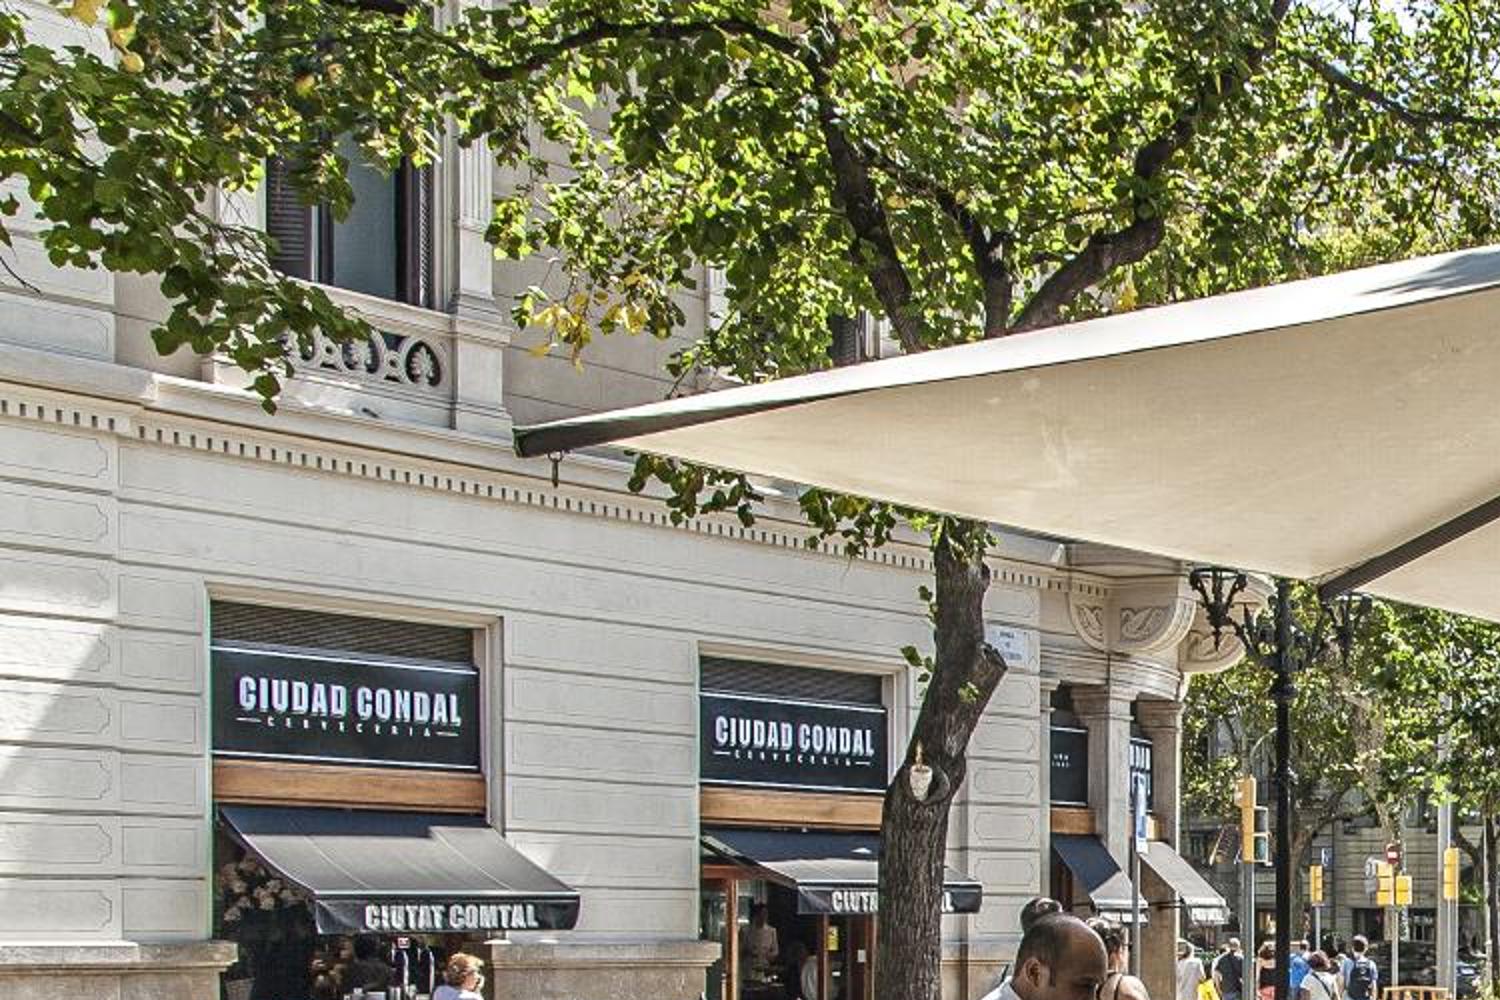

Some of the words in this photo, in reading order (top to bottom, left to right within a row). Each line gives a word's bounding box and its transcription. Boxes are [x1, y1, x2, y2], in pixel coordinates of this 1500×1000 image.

[238, 676, 347, 718] CIUDAD
[356, 686, 462, 727] CONDAL
[714, 715, 793, 750] CIUDAD
[798, 723, 875, 757] CONDAL
[365, 904, 446, 930] CIUTAT
[450, 904, 539, 929] COMTAL
[832, 890, 878, 913] CIUTA
